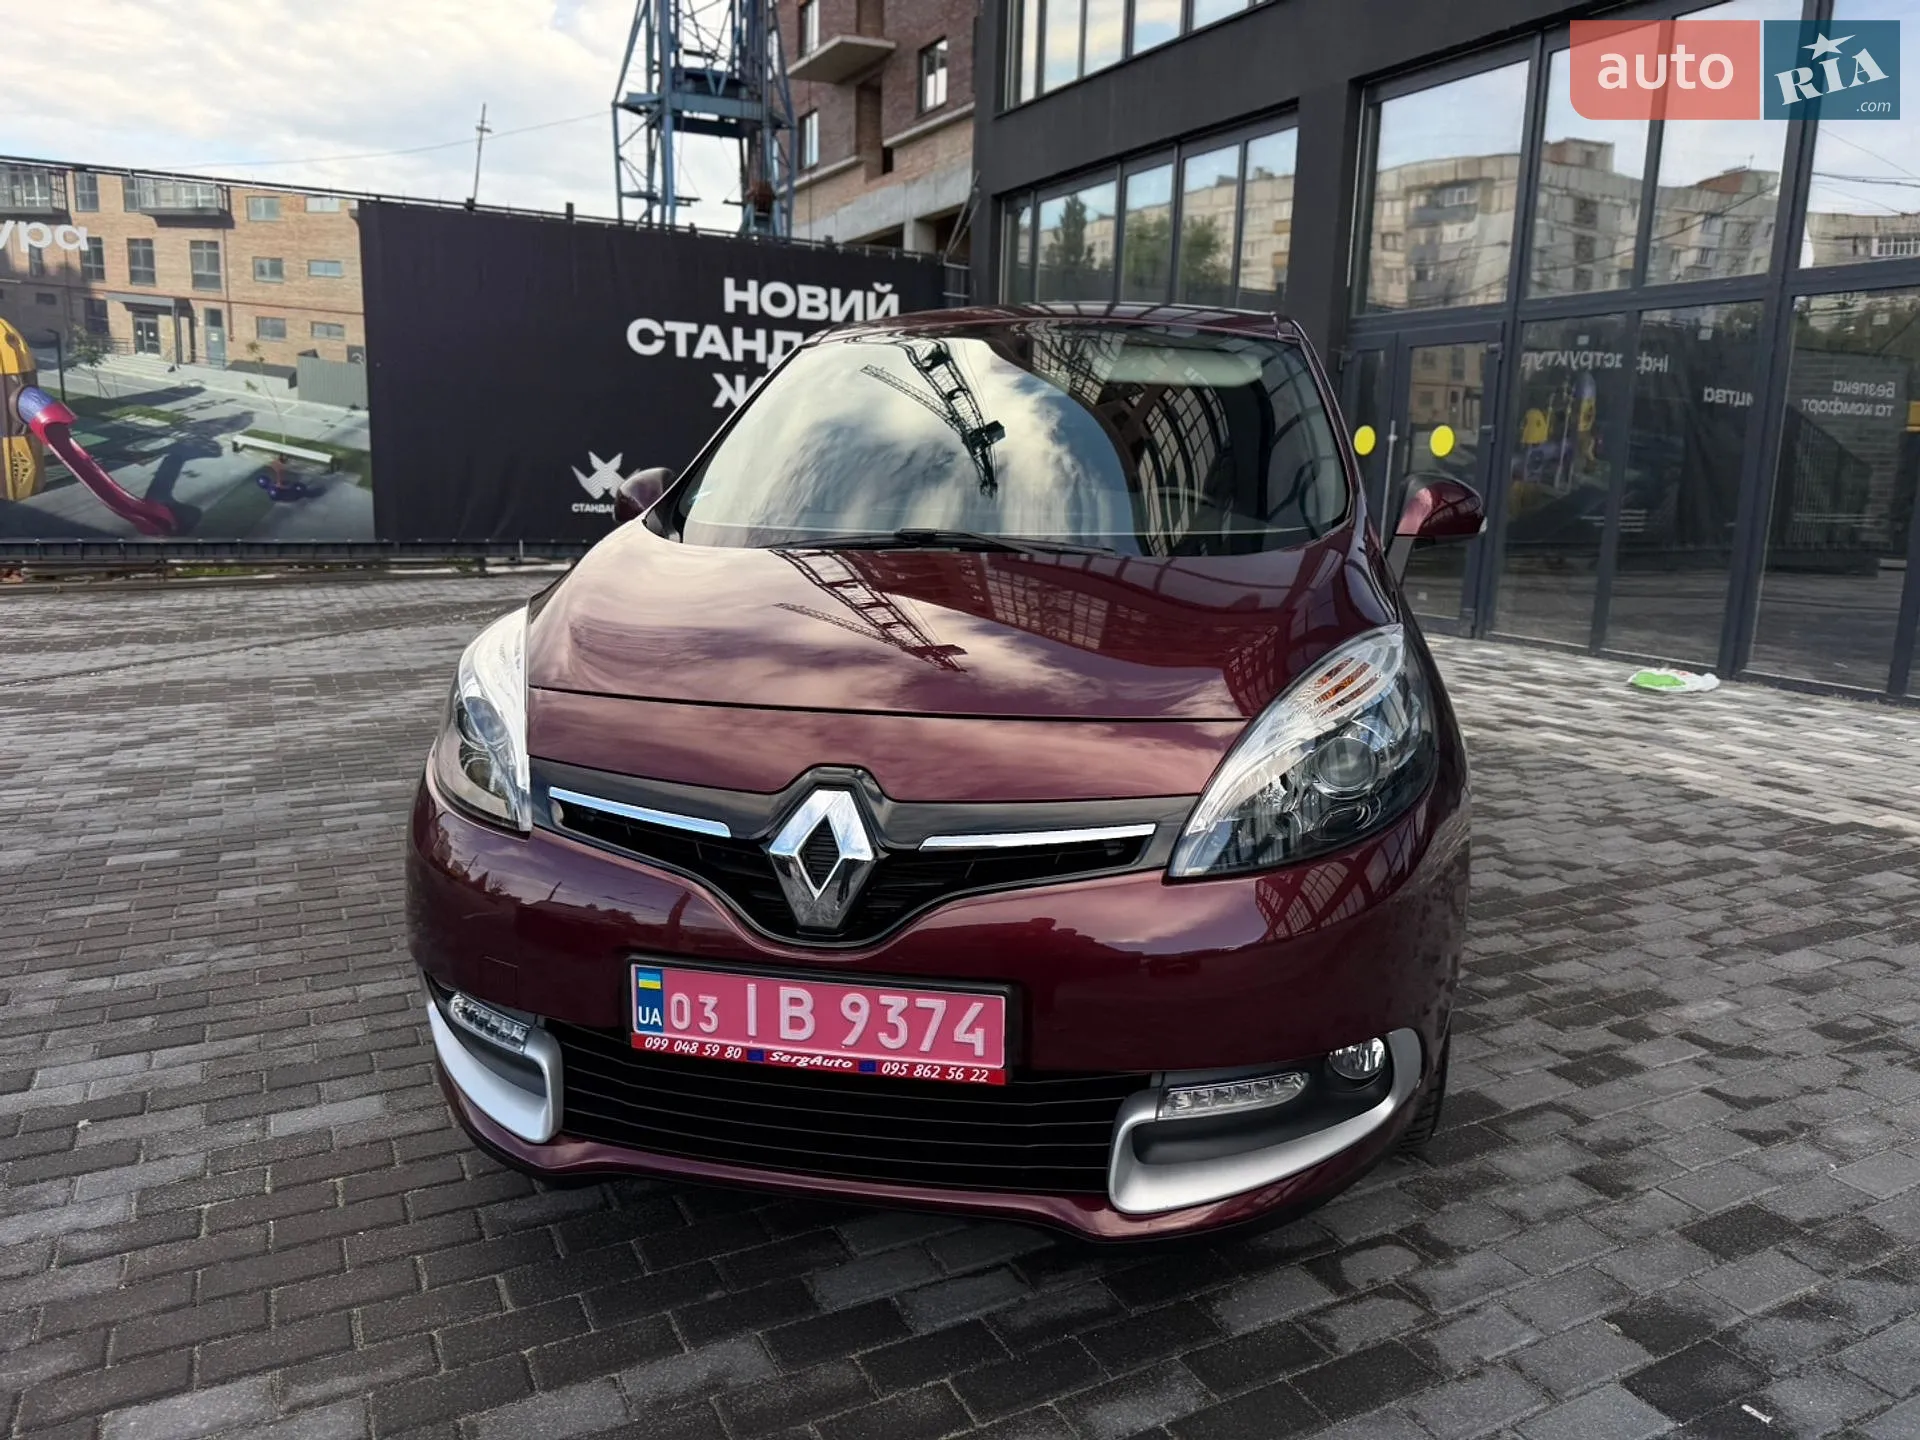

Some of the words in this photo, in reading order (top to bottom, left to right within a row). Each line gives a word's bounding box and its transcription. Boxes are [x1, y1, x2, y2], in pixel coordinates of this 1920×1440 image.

[723, 277, 900, 322] НОВИЙ
[626, 317, 804, 370] СТАНД
[638, 1006, 663, 1027] UA
[669, 992, 719, 1034] 03
[840, 992, 985, 1057] 9374
[644, 1037, 669, 1050] 099
[673, 1040, 698, 1054] 048
[702, 1044, 720, 1057] 59
[724, 1046, 742, 1059] 80
[769, 1051, 853, 1068] SergAuto
[881, 1062, 909, 1076] 095
[913, 1065, 940, 1079] 862
[945, 1067, 964, 1080] 56
[970, 1070, 989, 1083] 22
